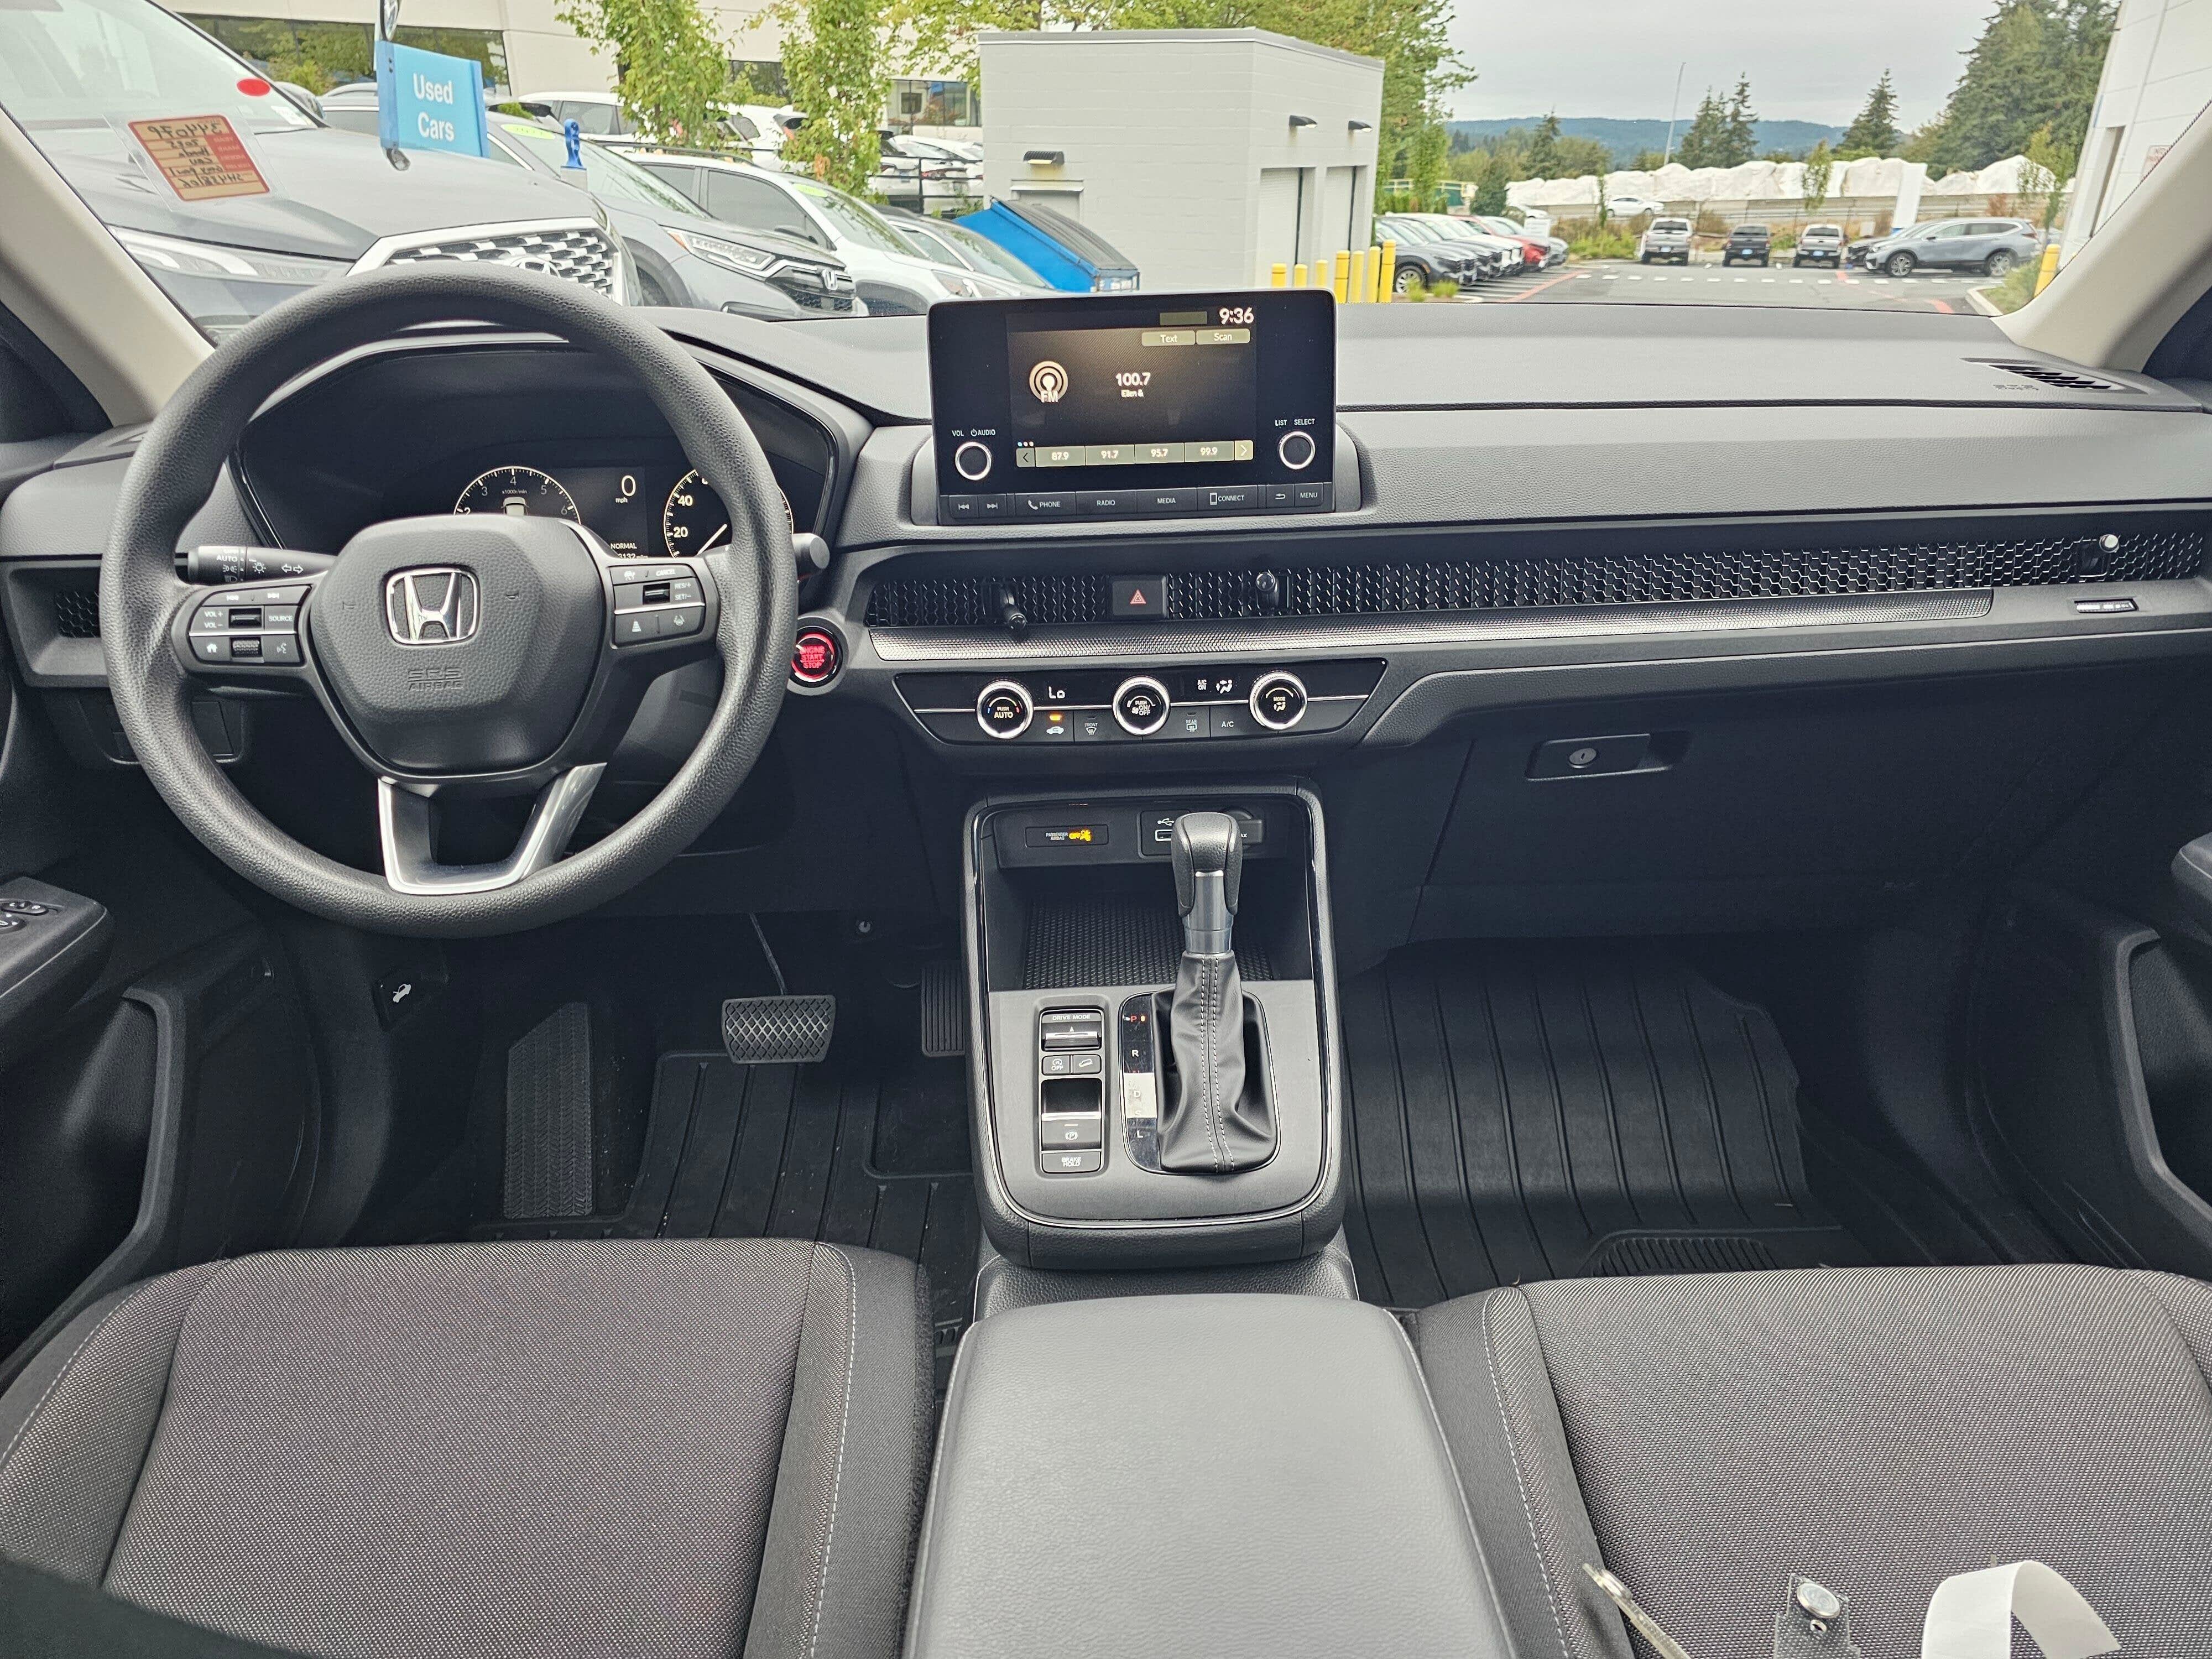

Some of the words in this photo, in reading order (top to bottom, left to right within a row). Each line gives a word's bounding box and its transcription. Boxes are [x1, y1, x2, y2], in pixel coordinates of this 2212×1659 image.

[413, 72, 453, 105] Used
[418, 112, 455, 142] Cars
[1219, 307, 1254, 325] 9:36
[1160, 335, 1178, 343] Text
[1214, 333, 1233, 341] Scan
[1115, 372, 1151, 387] 100.7
[1040, 390, 1058, 403] FM
[1100, 450, 1119, 459] 91.7
[1150, 448, 1168, 457] 95.7
[1200, 447, 1218, 456] 99.9
[1051, 452, 1070, 461] 87.9
[510, 477, 517, 486] 4
[621, 475, 636, 497] 0
[482, 487, 488, 495] 3
[541, 486, 547, 494] 5
[677, 495, 693, 507] 40
[561, 507, 567, 515] 6
[673, 526, 688, 538] 20
